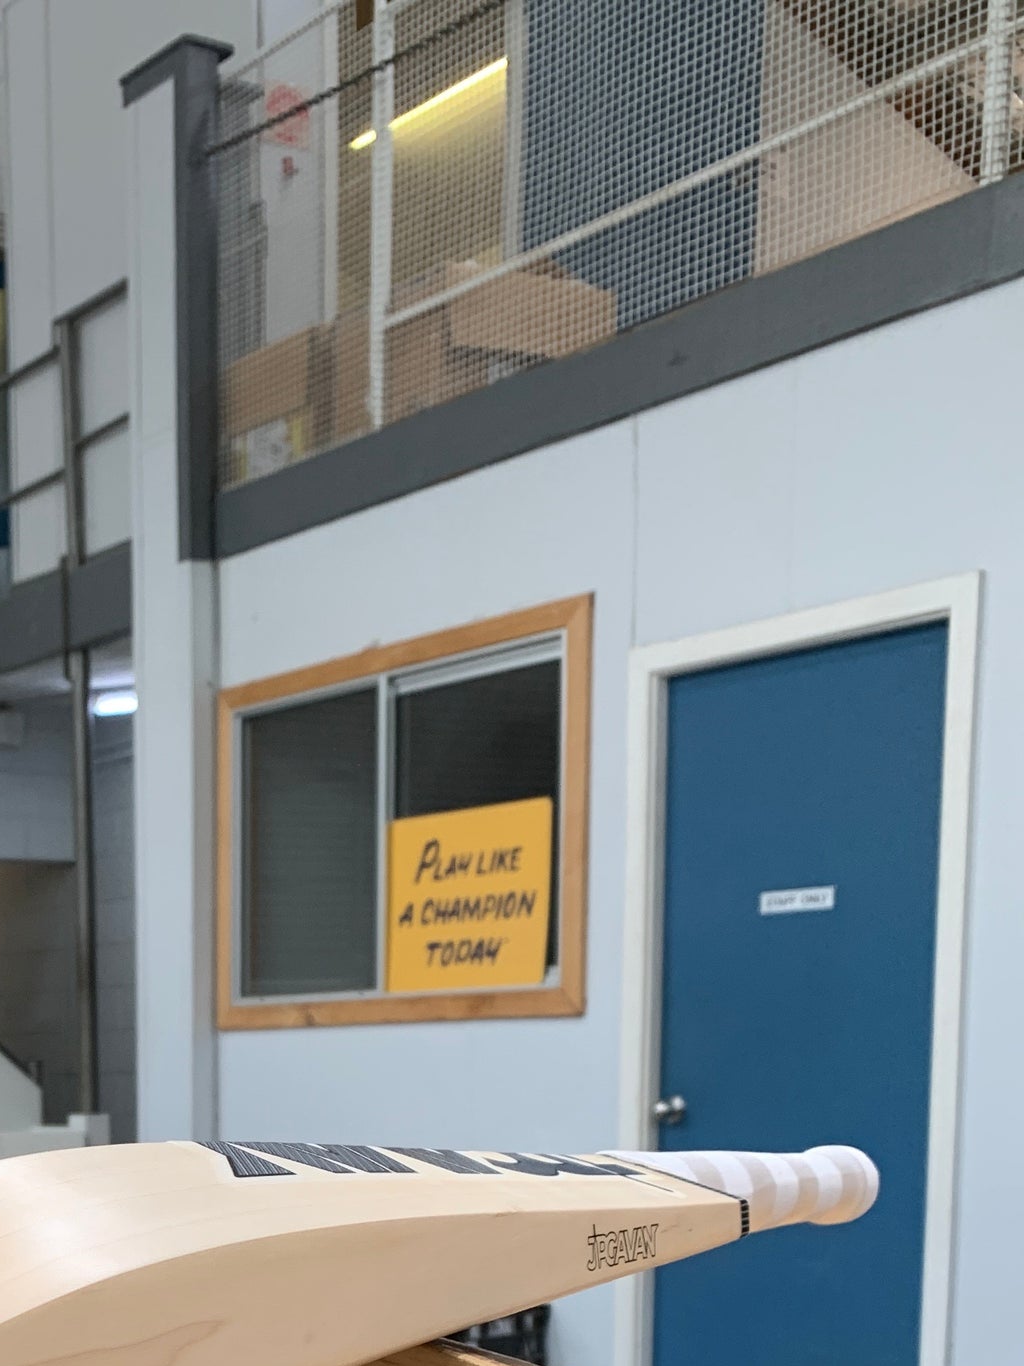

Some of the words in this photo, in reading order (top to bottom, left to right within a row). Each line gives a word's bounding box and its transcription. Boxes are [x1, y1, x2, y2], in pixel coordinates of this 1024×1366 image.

[476, 846, 524, 876] LIKE
[398, 901, 415, 928] A
[419, 889, 538, 927] CHAMPION
[426, 937, 503, 968] TODAY
